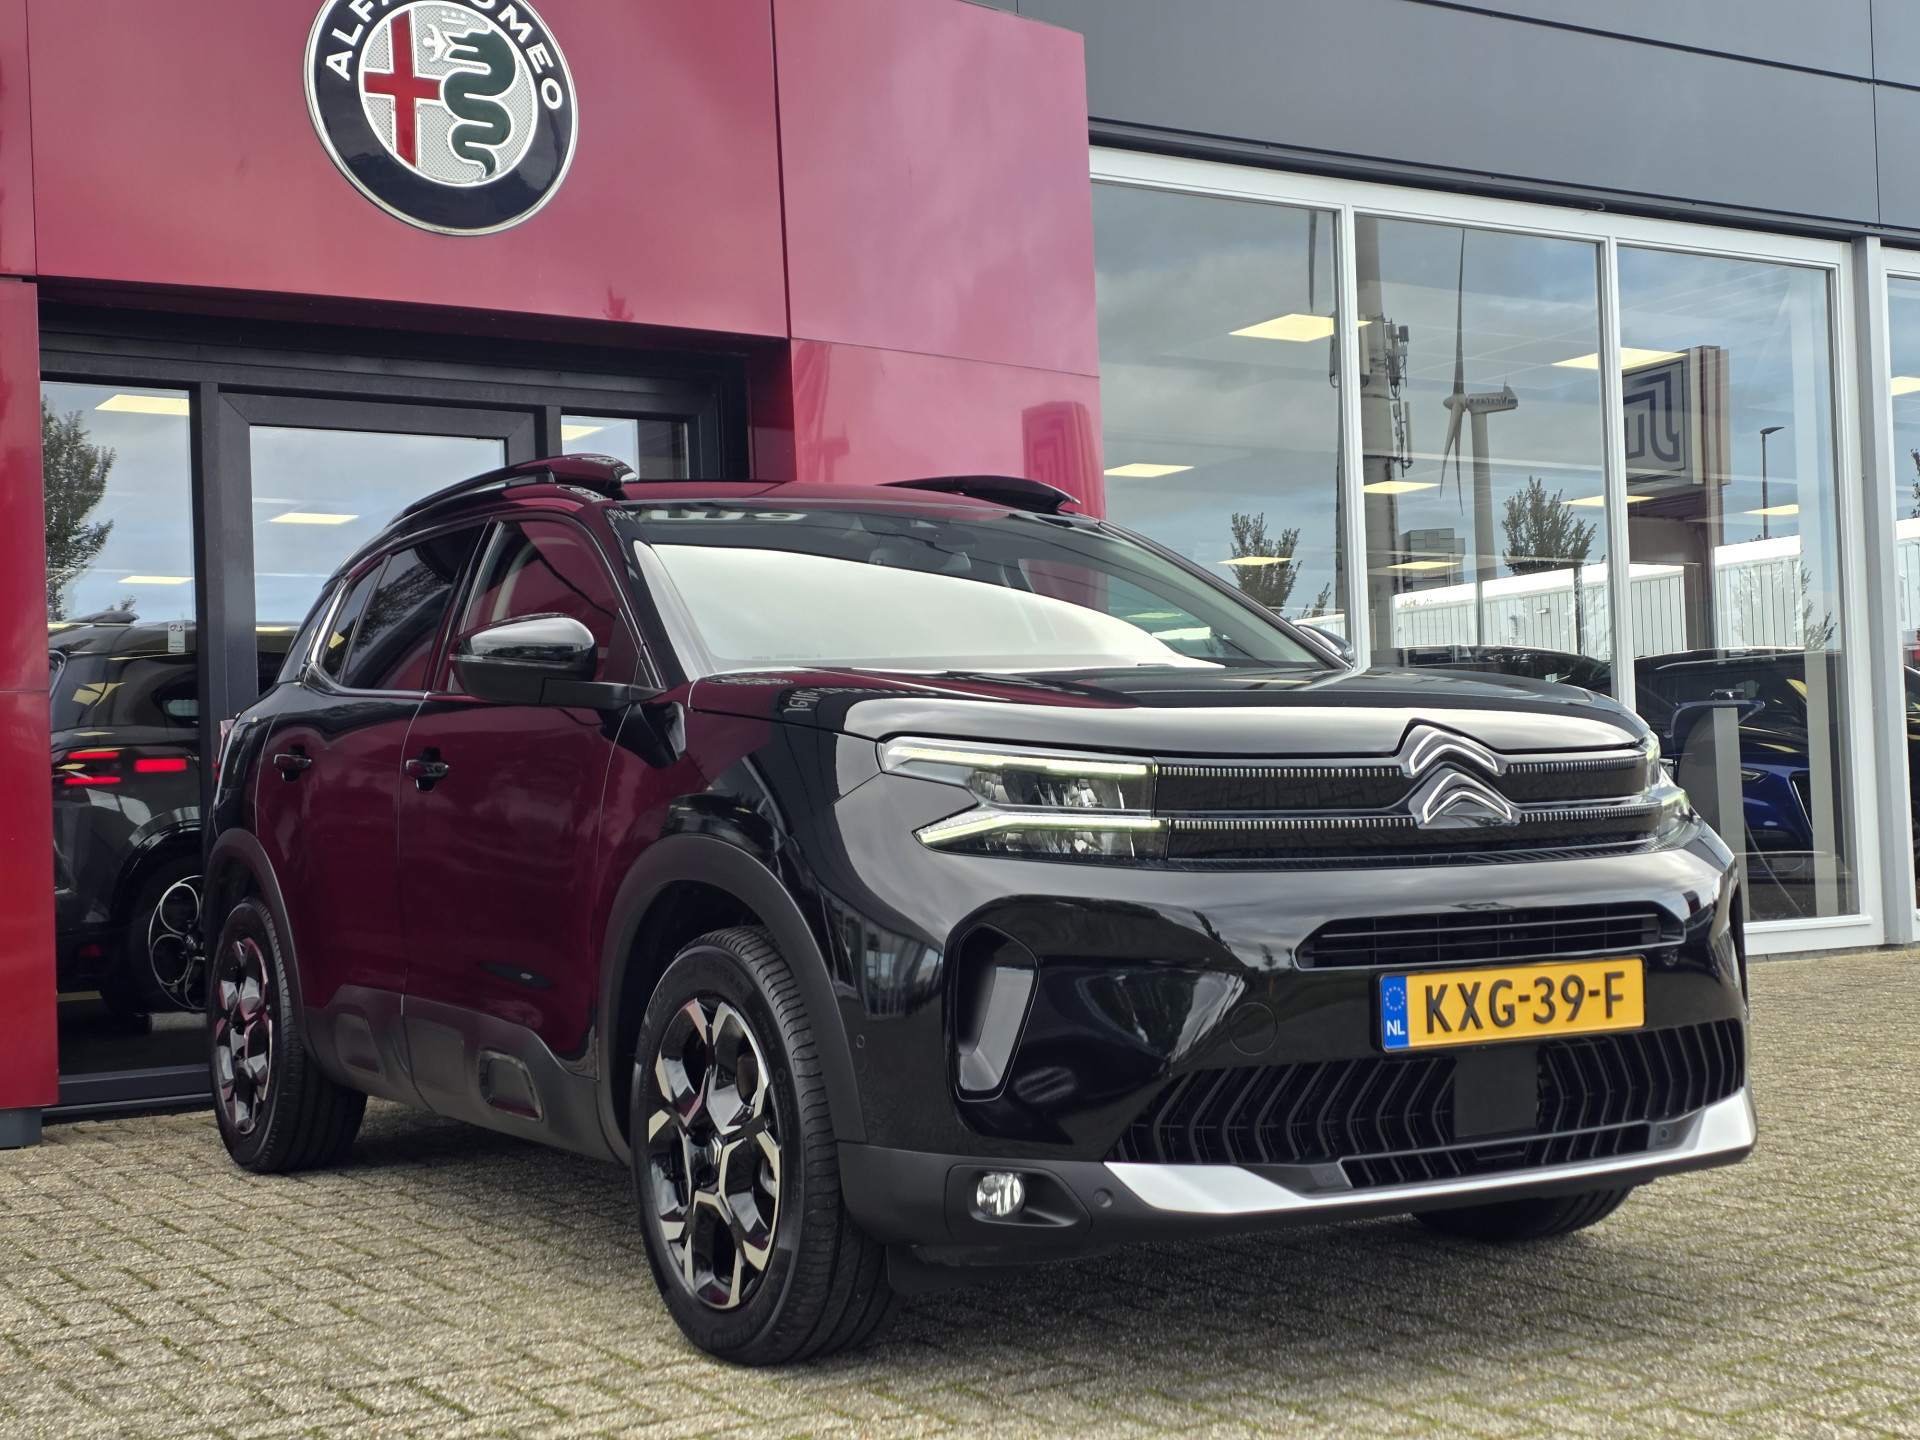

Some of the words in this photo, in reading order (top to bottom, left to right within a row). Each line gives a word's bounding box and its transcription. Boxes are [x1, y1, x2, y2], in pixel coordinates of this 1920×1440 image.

[326, 0, 390, 82] ALF
[1386, 1019, 1406, 1036] NL
[1425, 970, 1625, 1034] KXG-39-F
